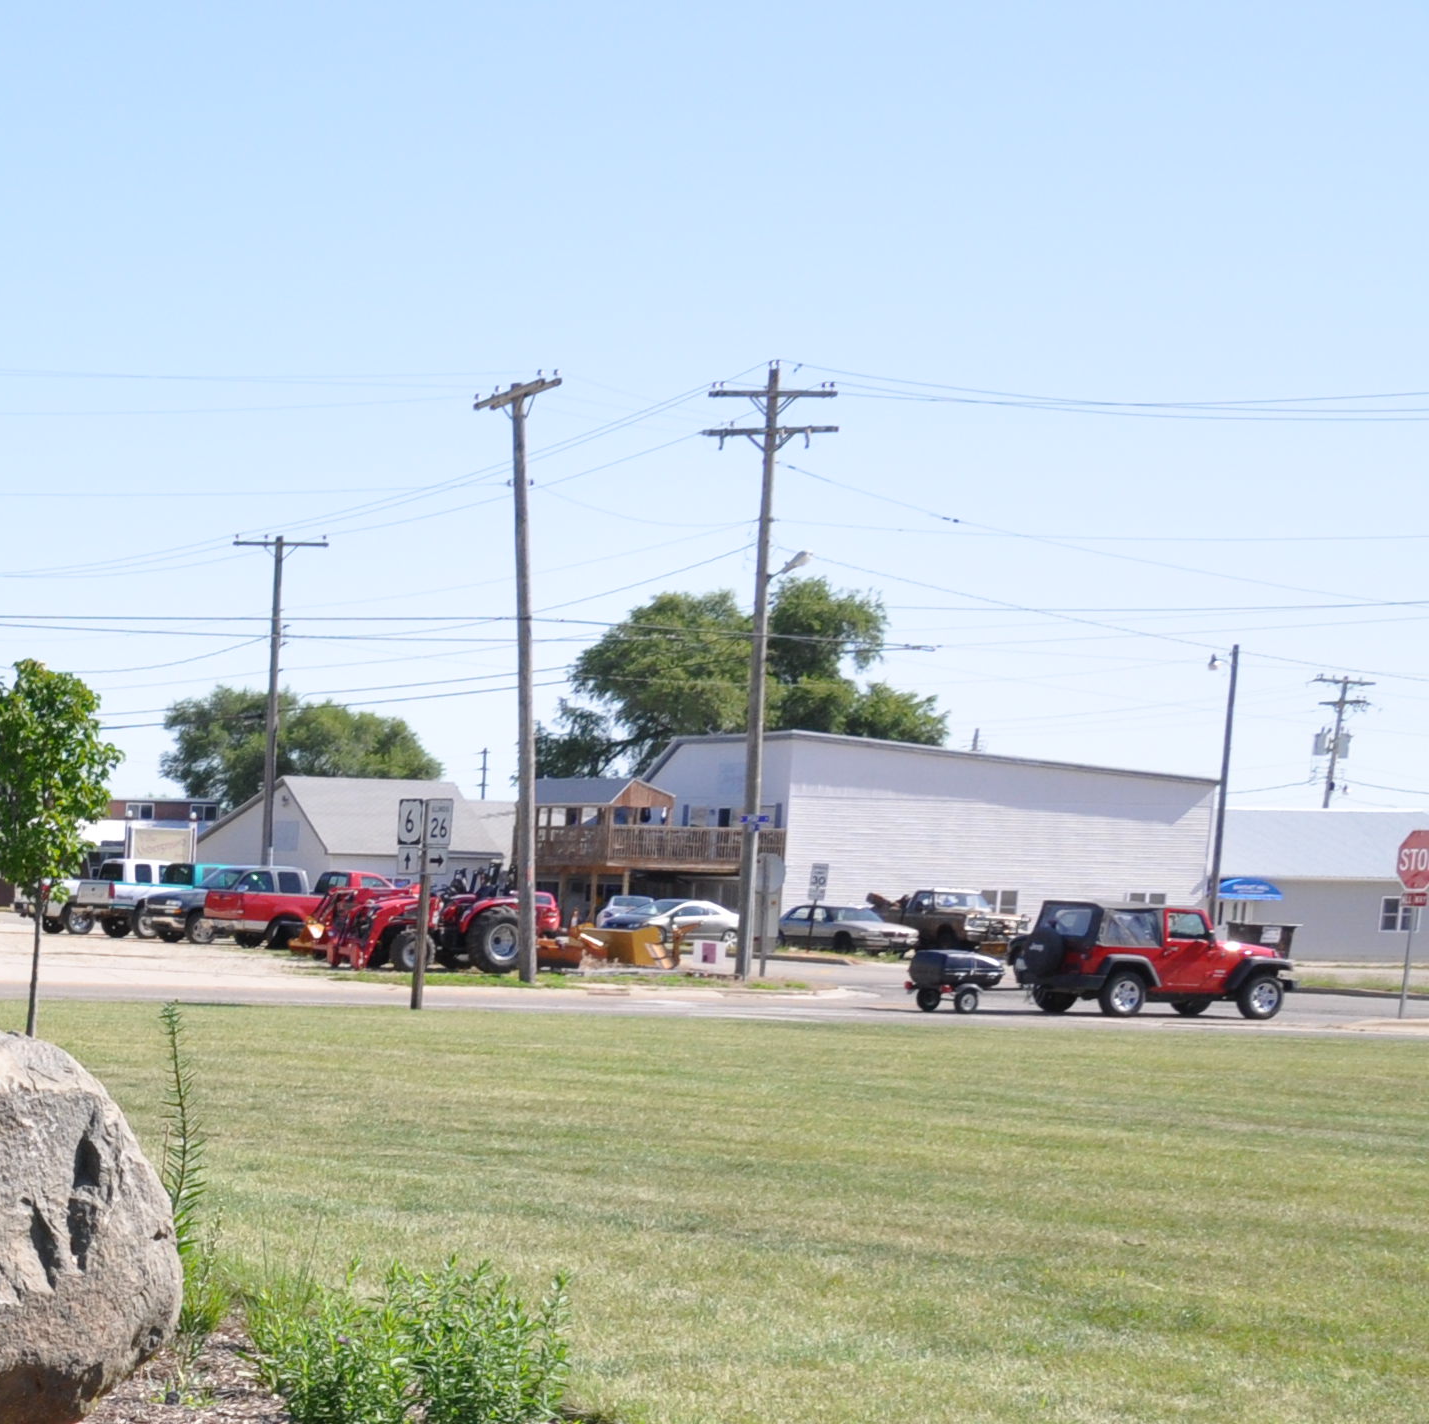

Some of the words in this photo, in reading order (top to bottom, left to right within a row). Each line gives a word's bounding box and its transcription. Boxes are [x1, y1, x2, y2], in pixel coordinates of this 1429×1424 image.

[405, 808, 415, 834] 6
[430, 817, 448, 839] 26
[1399, 848, 1429, 871] STO
[811, 875, 827, 887] 30
